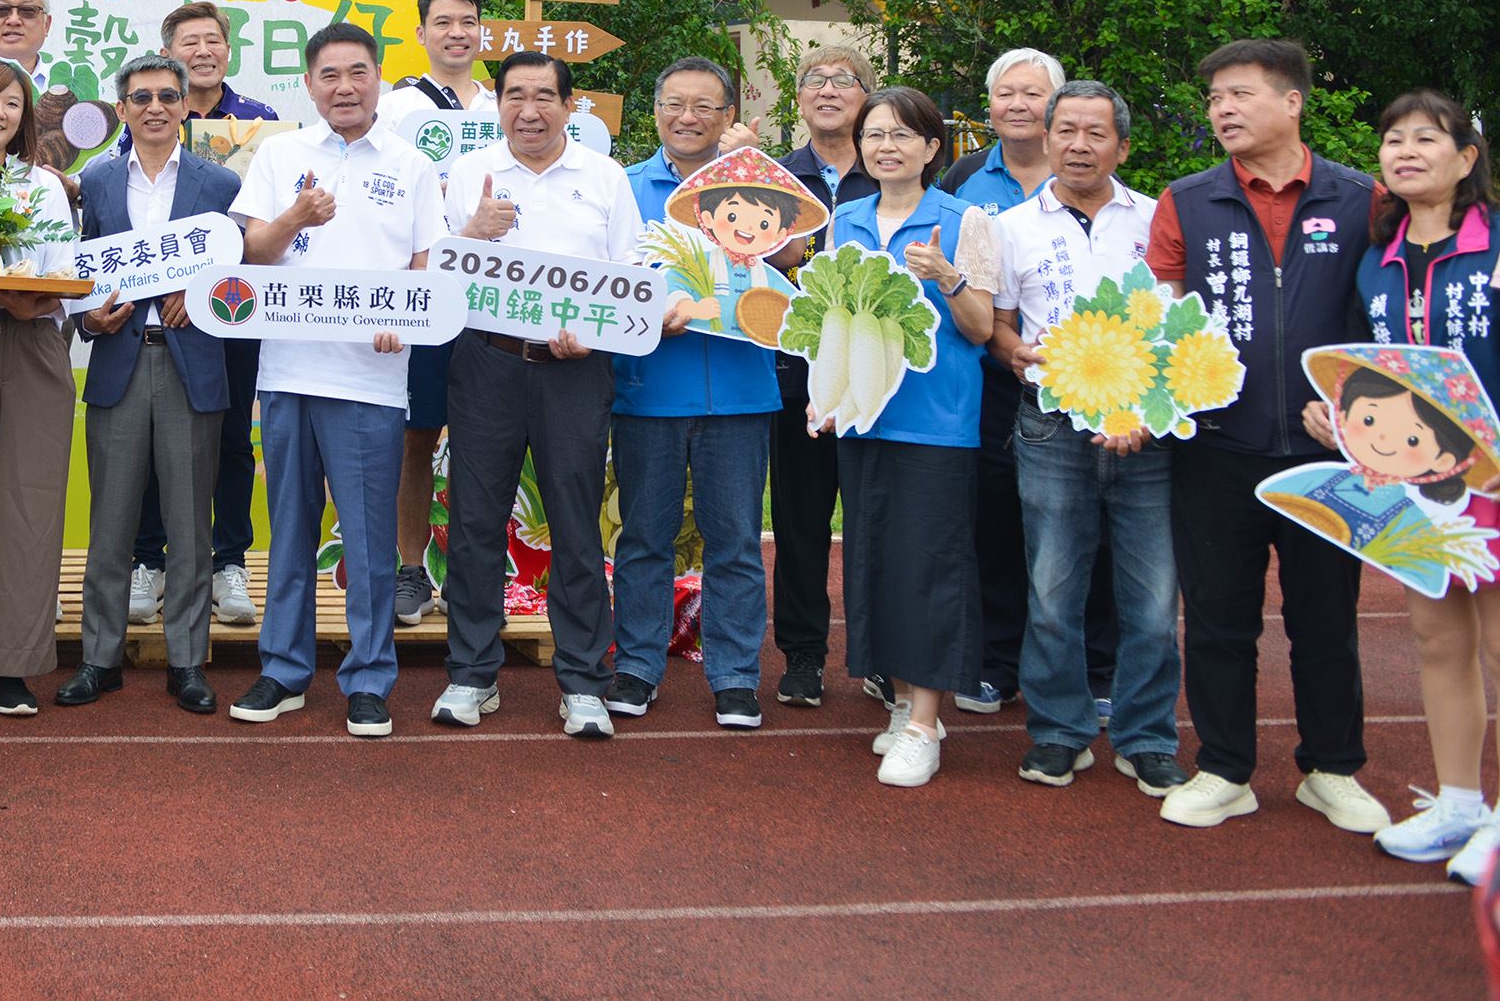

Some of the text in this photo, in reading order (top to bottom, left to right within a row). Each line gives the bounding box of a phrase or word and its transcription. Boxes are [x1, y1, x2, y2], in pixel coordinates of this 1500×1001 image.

[75, 227, 211, 280] 客家委員會
[1205, 238, 1223, 268] 村長
[88, 281, 113, 298] kka
[119, 272, 160, 291] Affairs
[439, 249, 653, 303] 2026/06/06
[262, 282, 432, 312] 苗栗縣政府
[465, 282, 618, 337] 銅鑼中平
[1467, 270, 1491, 338] 中平村
[264, 311, 431, 328] Miaoli County Government
